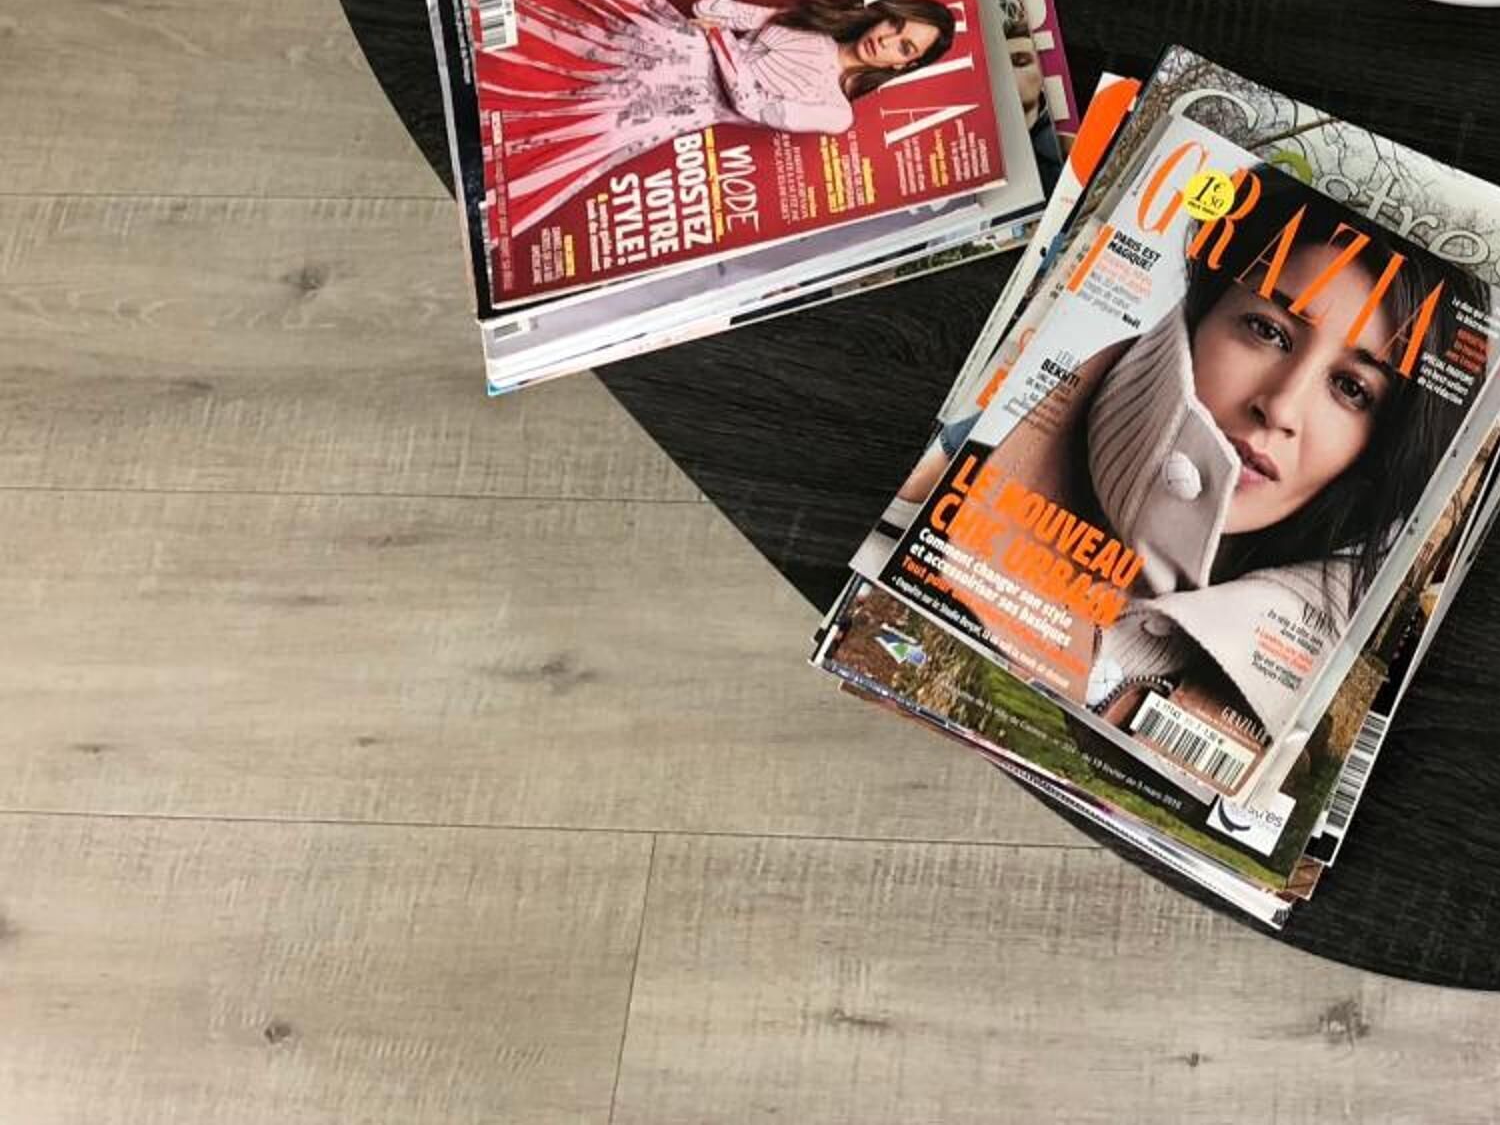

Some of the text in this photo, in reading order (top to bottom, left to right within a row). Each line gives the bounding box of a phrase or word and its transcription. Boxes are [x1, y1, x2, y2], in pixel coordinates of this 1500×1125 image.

[608, 170, 647, 266] STYLE!
[642, 168, 680, 258] VOTRE
[672, 131, 714, 250] BOOSTEZ
[713, 142, 764, 241] MODE
[1106, 240, 1154, 272] MAGIQUE!
[1112, 230, 1162, 263] PARIS EST
[1123, 132, 1465, 381] GRAZIA
[901, 555, 930, 579] Tout
[949, 453, 1151, 594] LE NOUVEAU
[908, 540, 927, 559] et
[996, 595, 1021, 616] ses
[1015, 606, 1073, 650] basiques
[916, 526, 1075, 631] Comment changer son style
[996, 531, 1130, 633] URBAIN
